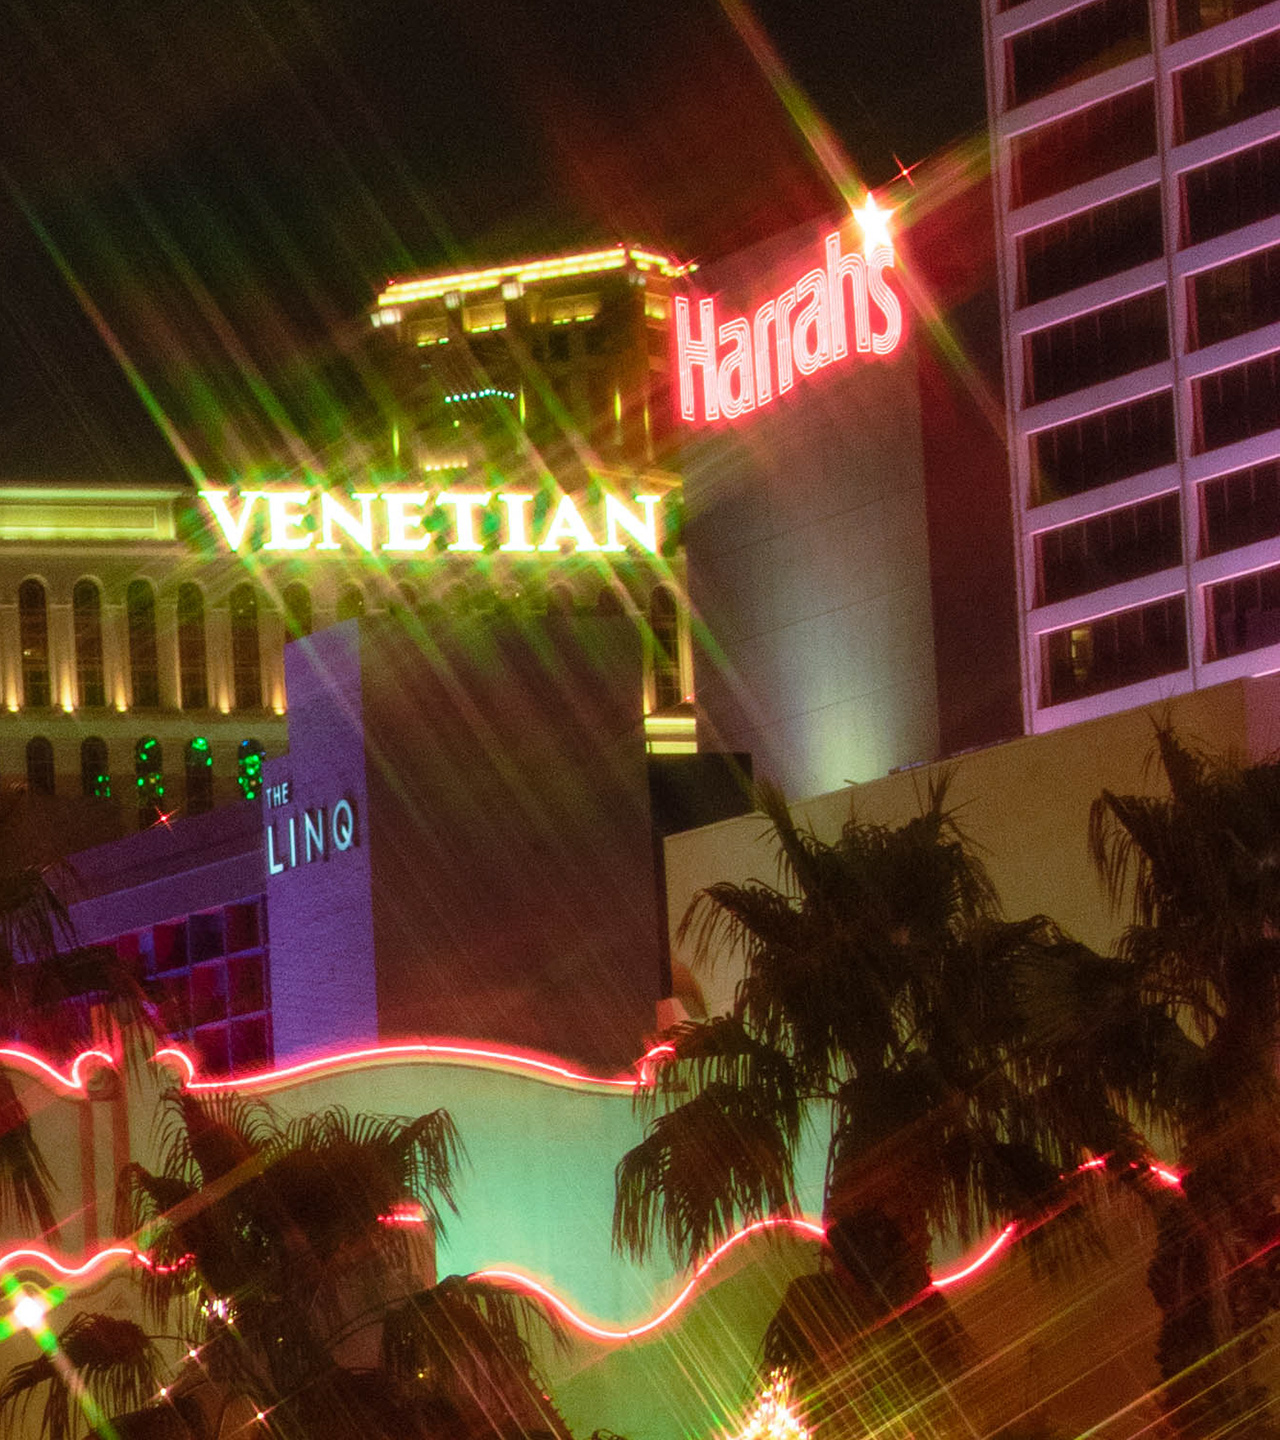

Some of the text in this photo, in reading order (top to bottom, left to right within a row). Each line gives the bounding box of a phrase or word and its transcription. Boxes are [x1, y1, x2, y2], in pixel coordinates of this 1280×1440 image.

[197, 489, 662, 554] VENETIAN
[265, 781, 290, 809] THE
[266, 797, 355, 877] LINQ
